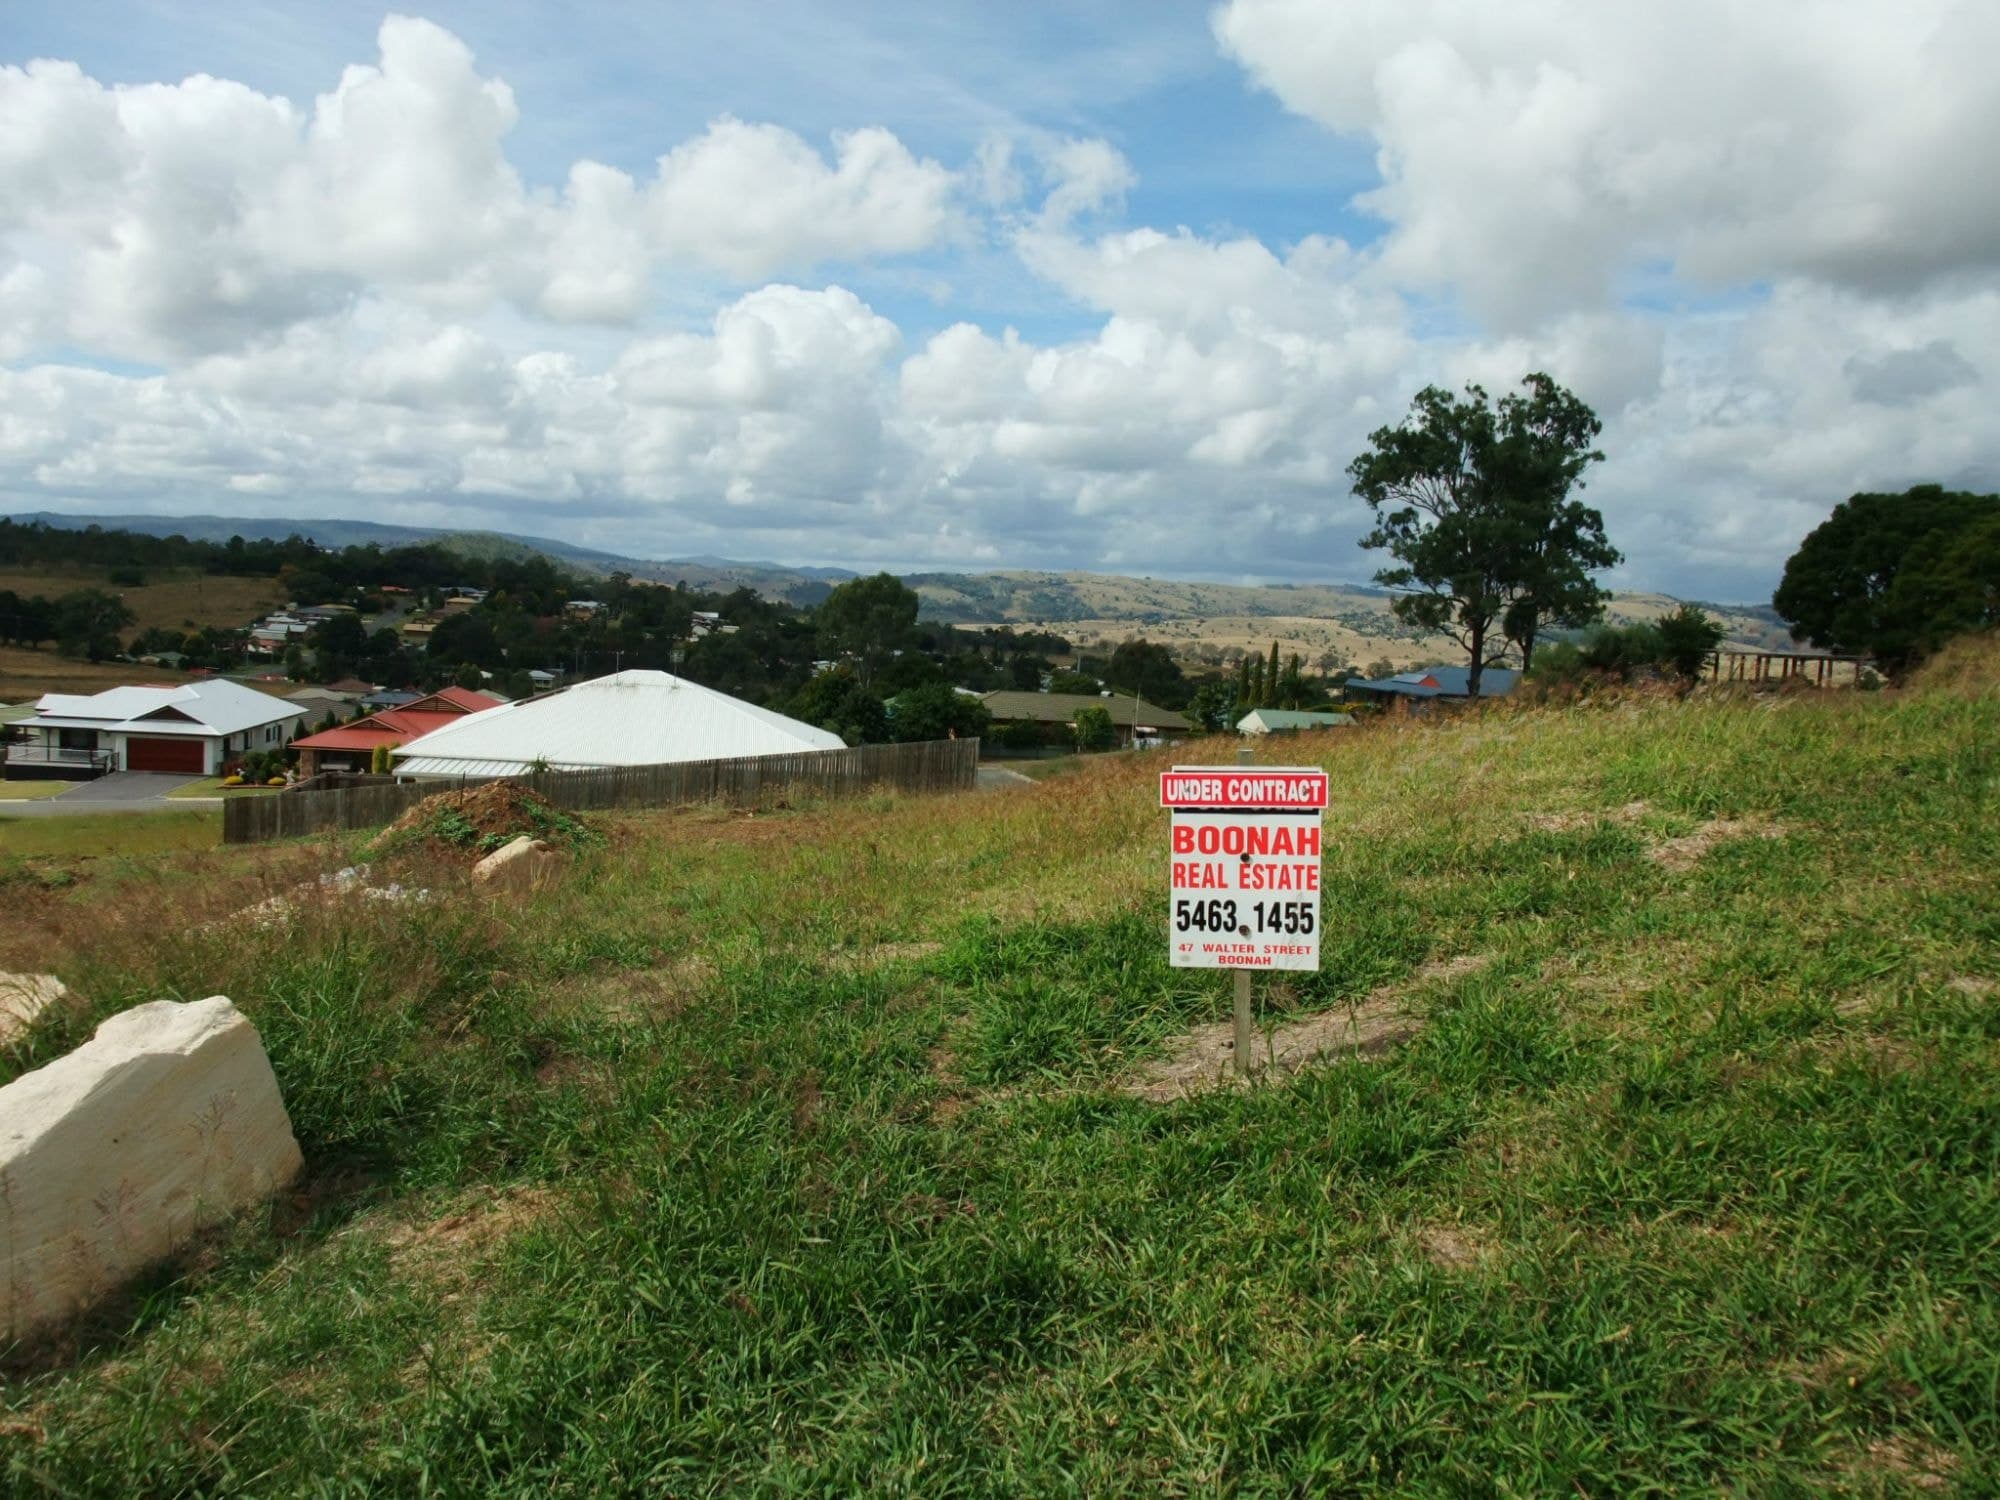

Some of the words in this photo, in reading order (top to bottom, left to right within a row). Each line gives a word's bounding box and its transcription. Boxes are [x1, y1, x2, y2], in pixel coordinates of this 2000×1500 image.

[1166, 779, 1223, 801] UNDER
[1227, 779, 1322, 802] CONTRACT
[1173, 825, 1319, 856] BOONAH
[1173, 862, 1228, 889] REAL
[1239, 863, 1318, 891] ESTATE
[1176, 899, 1237, 933] 5463
[1253, 901, 1314, 935] 1455
[1178, 943, 1194, 952] 47
[1203, 944, 1255, 954] WALTER
[1263, 945, 1312, 955] STREET
[1218, 955, 1272, 965] BOONAH
